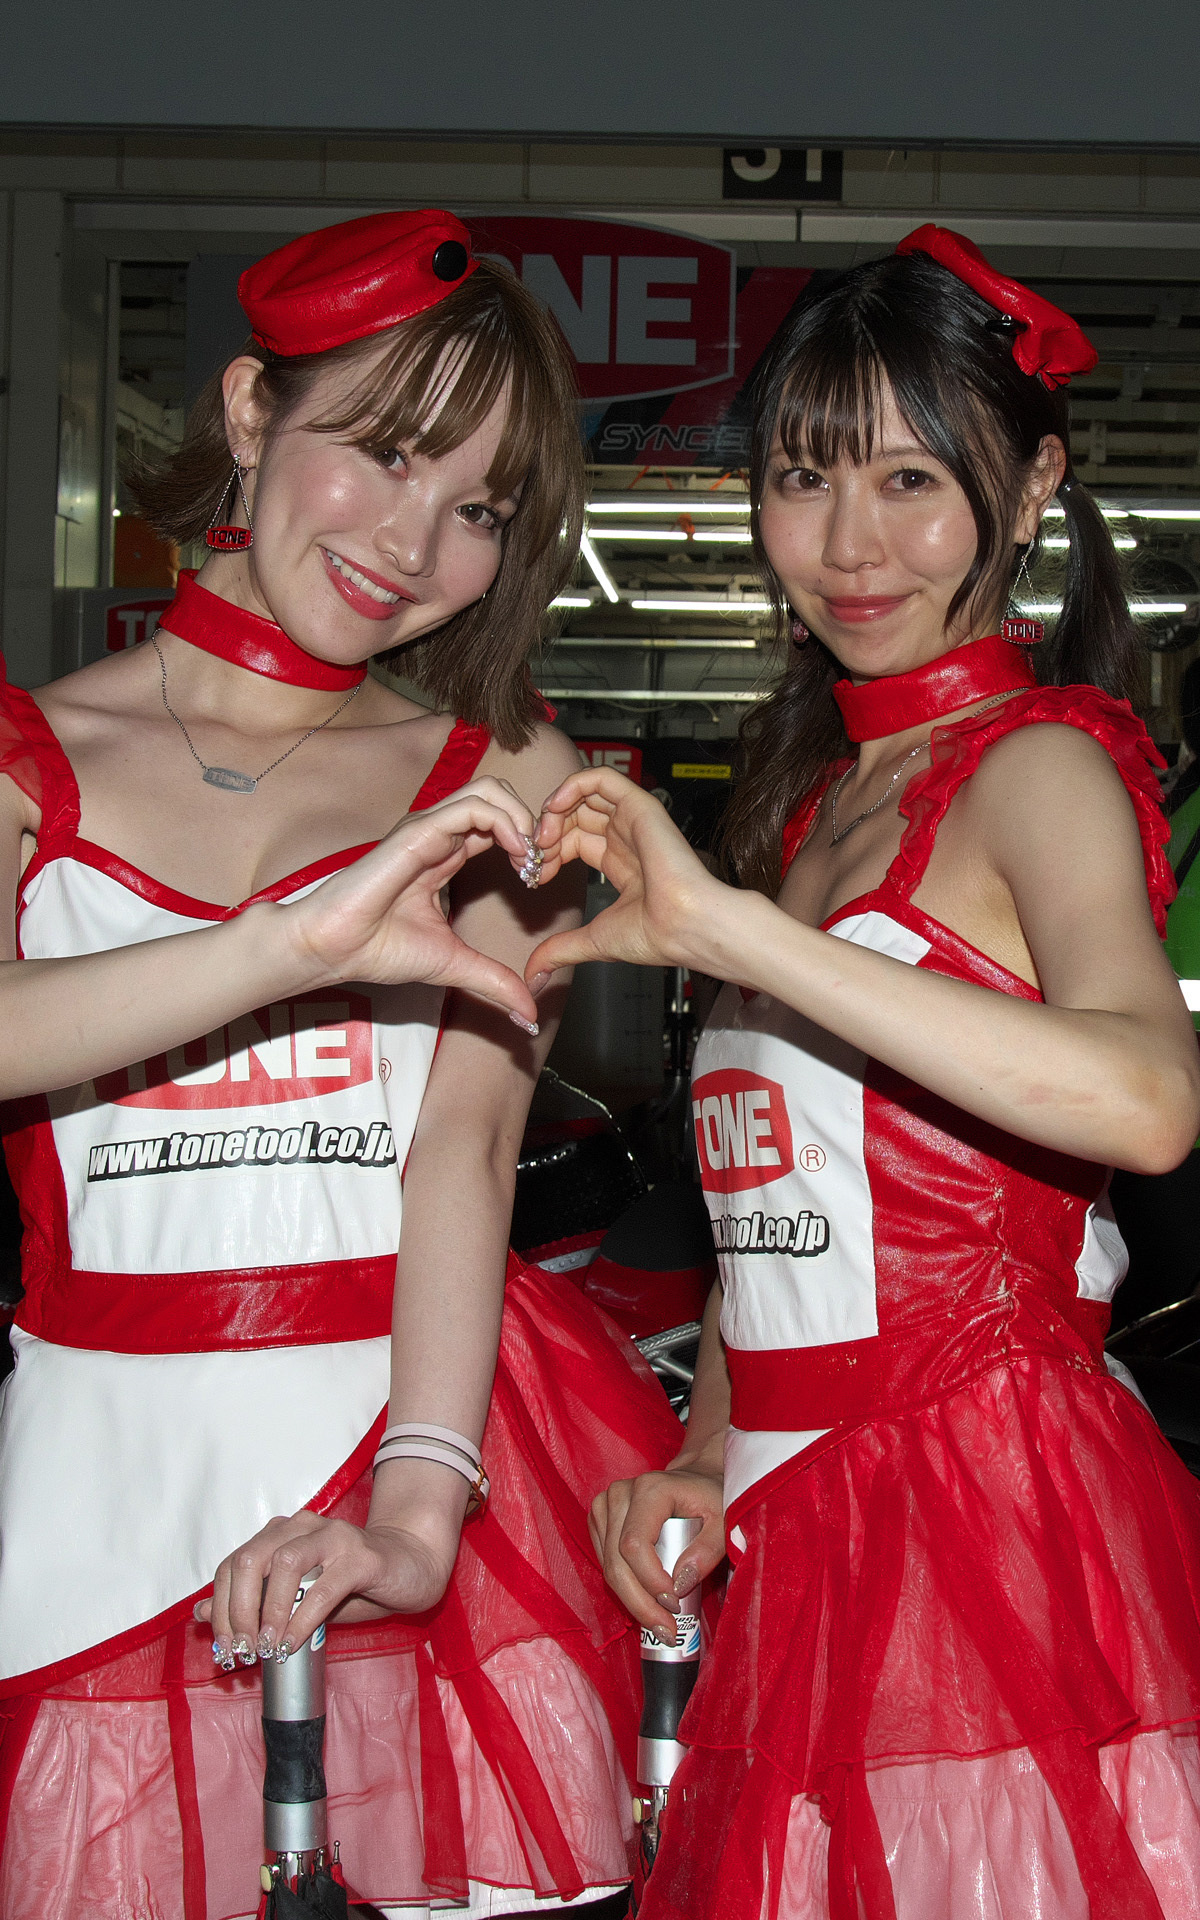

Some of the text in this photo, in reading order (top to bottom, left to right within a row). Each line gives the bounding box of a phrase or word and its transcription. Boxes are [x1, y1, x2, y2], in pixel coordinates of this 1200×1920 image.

[600, 423, 751, 453] SYNCE
[210, 530, 247, 544] TONE
[88, 1121, 397, 1182] www.tonetool.co.jp
